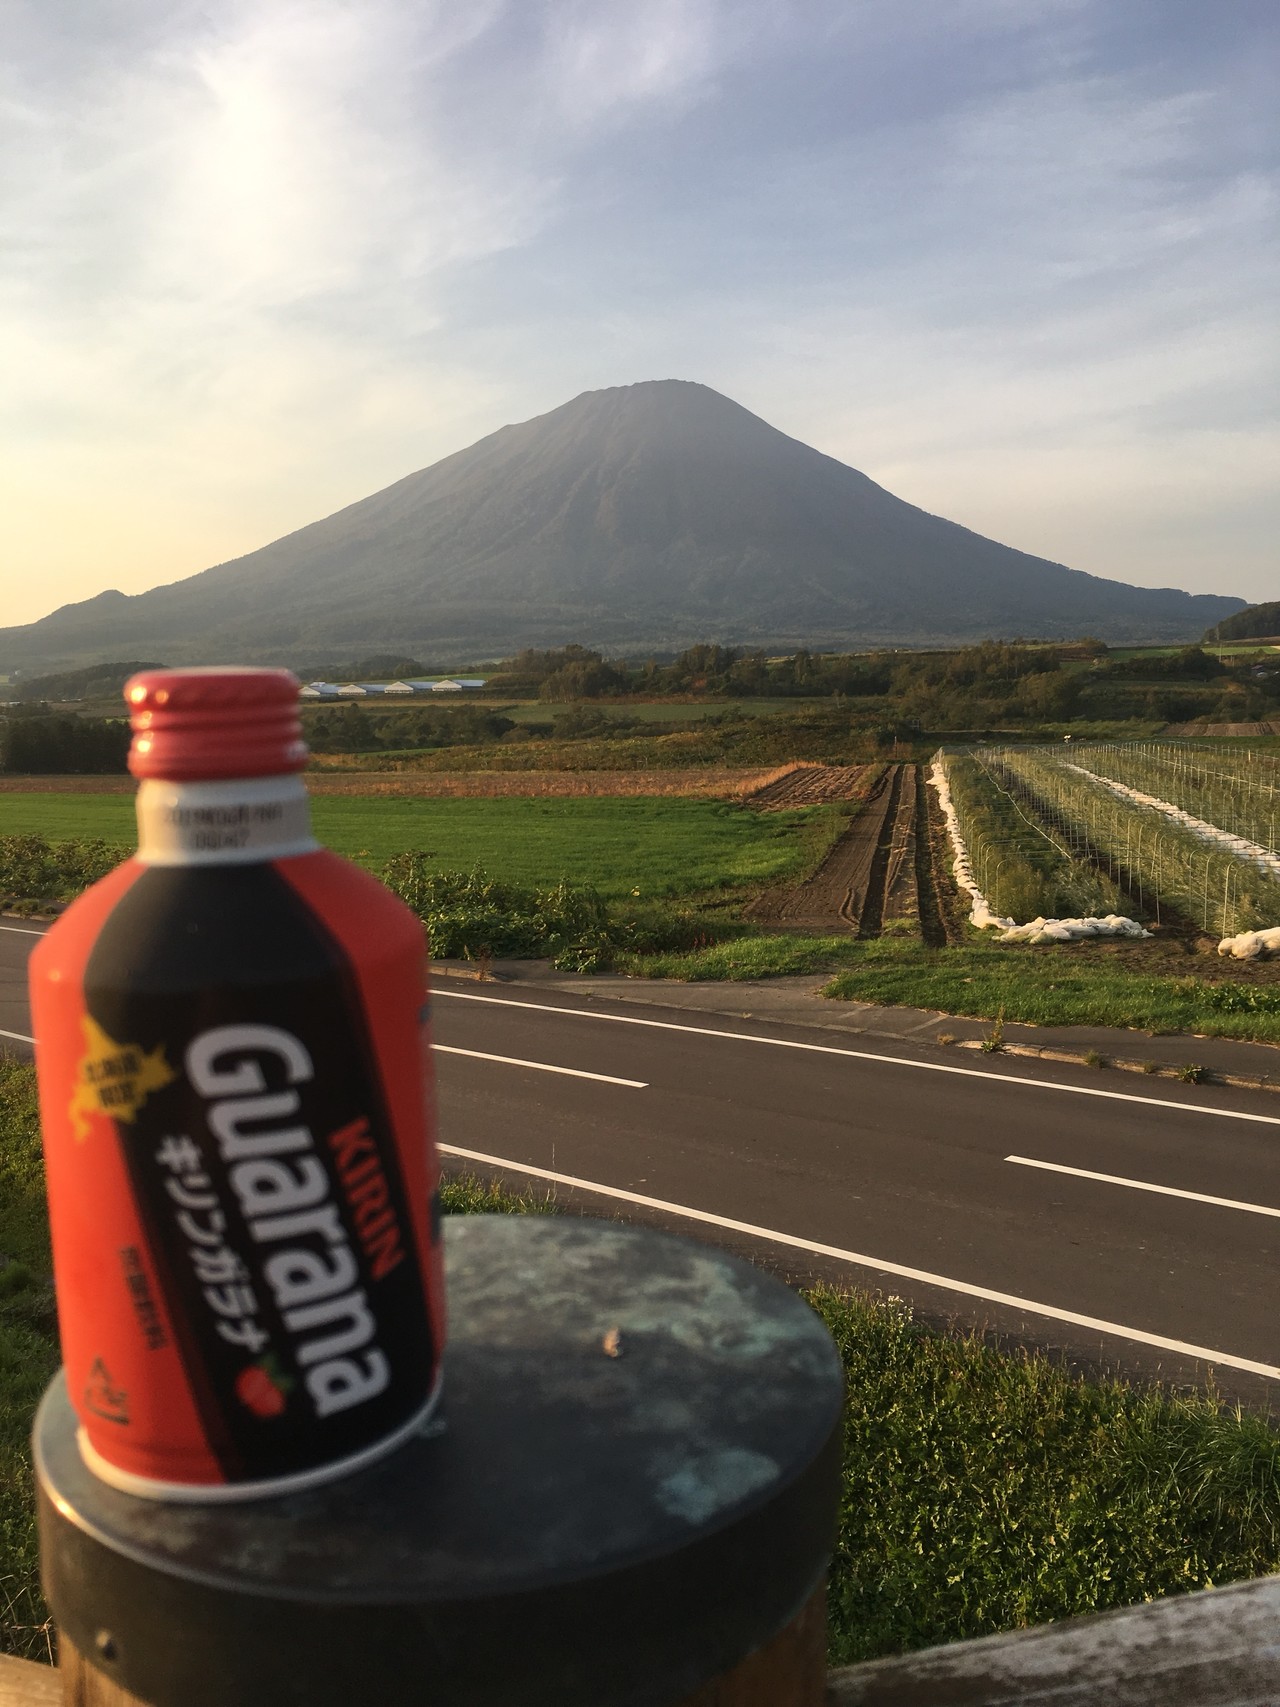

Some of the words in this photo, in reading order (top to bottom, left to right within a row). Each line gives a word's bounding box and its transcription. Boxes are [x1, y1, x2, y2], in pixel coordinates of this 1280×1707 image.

[155, 1134, 270, 1353] キリンガラナ
[185, 1024, 391, 1418] Guarana
[328, 1116, 404, 1281] KIRIN
